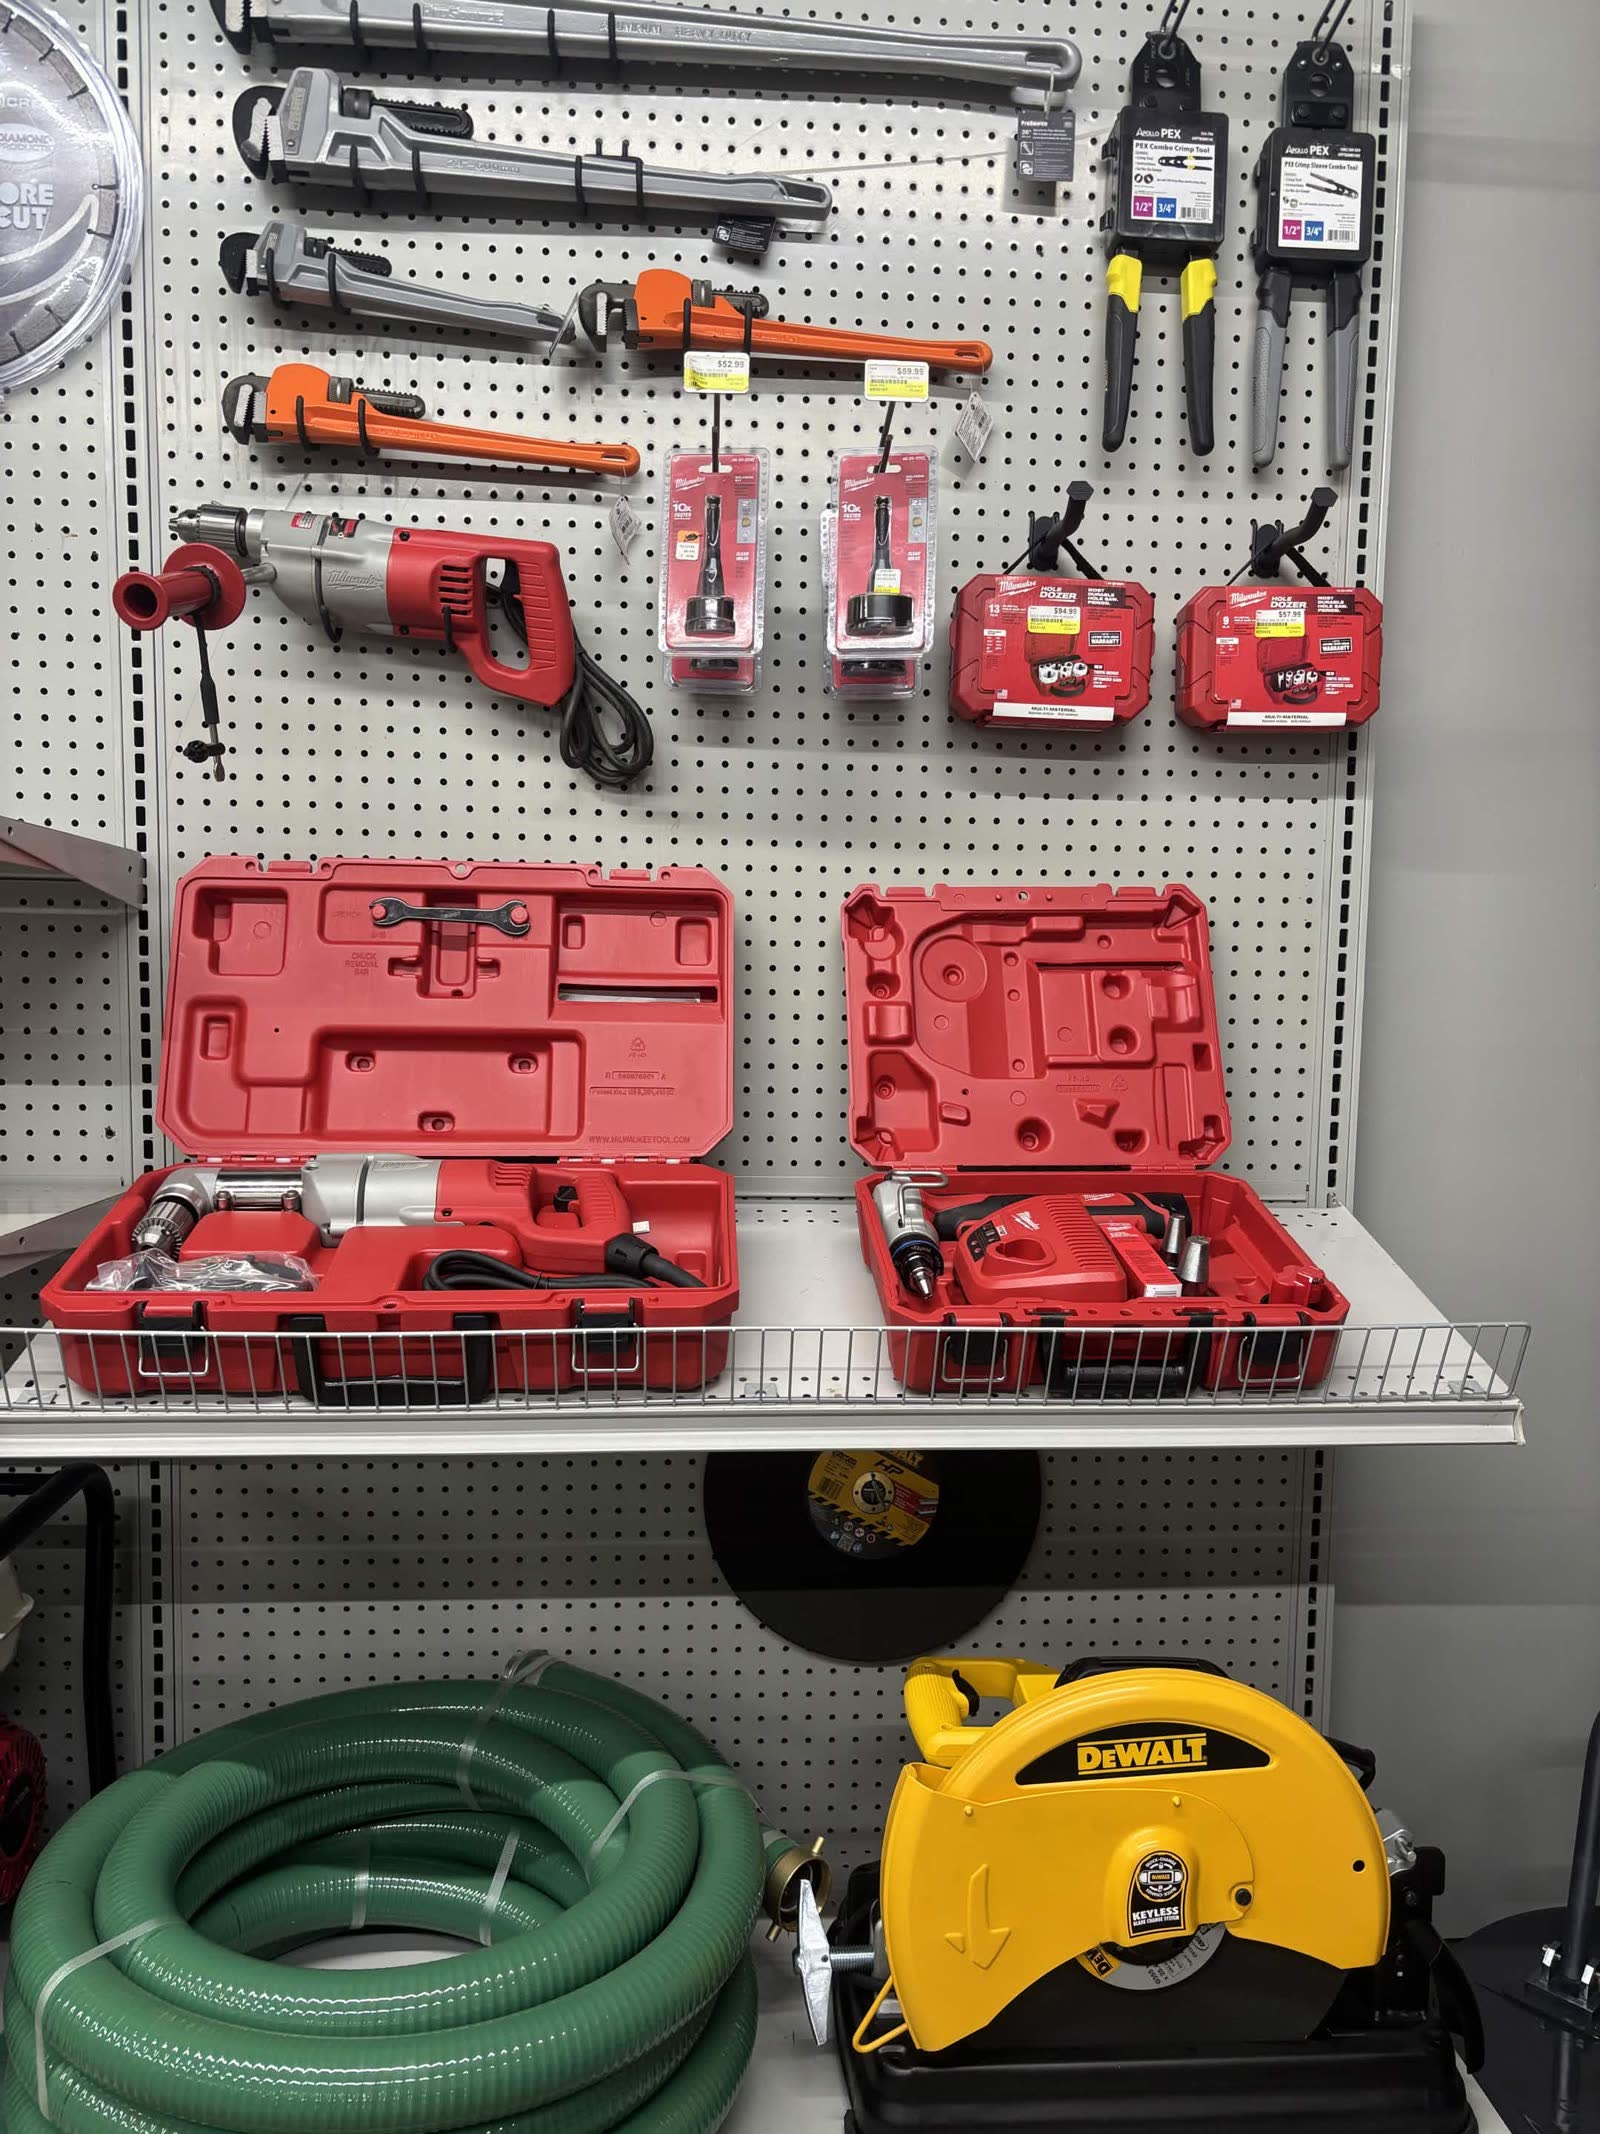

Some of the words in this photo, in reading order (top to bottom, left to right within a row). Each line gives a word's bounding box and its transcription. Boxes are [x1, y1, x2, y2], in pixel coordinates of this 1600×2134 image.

[599, 21, 663, 36] AUMINUM
[1161, 128, 1181, 139] PEX
[1149, 143, 1174, 151] Combo
[1174, 145, 1195, 153] Crimp
[1309, 145, 1330, 156] PEX
[0, 182, 54, 206] ORE
[1135, 202, 1153, 212] 1/2"
[1157, 203, 1175, 214] 3/4"
[1284, 226, 1301, 235] 1/2"
[1306, 227, 1323, 236] 3/4"
[717, 360, 745, 368] $52.99
[897, 367, 925, 376] $59.99
[672, 503, 692, 512] 10x
[842, 504, 861, 513] 10x
[327, 569, 383, 586] Milwaukee
[998, 580, 1037, 594] Milwaukee
[1229, 590, 1268, 606] Milwaukee
[989, 604, 1000, 614] 13
[1054, 607, 1078, 615] $94.99
[1222, 616, 1230, 626] 9
[352, 952, 377, 960] CHUCK
[345, 960, 379, 968] REMOVAL
[354, 968, 369, 976] BAR
[589, 1135, 691, 1144] WWW.MILWAUKEETOOL.COM
[874, 1460, 905, 1475] HP
[1132, 1906, 1179, 1921] KEYLESS
